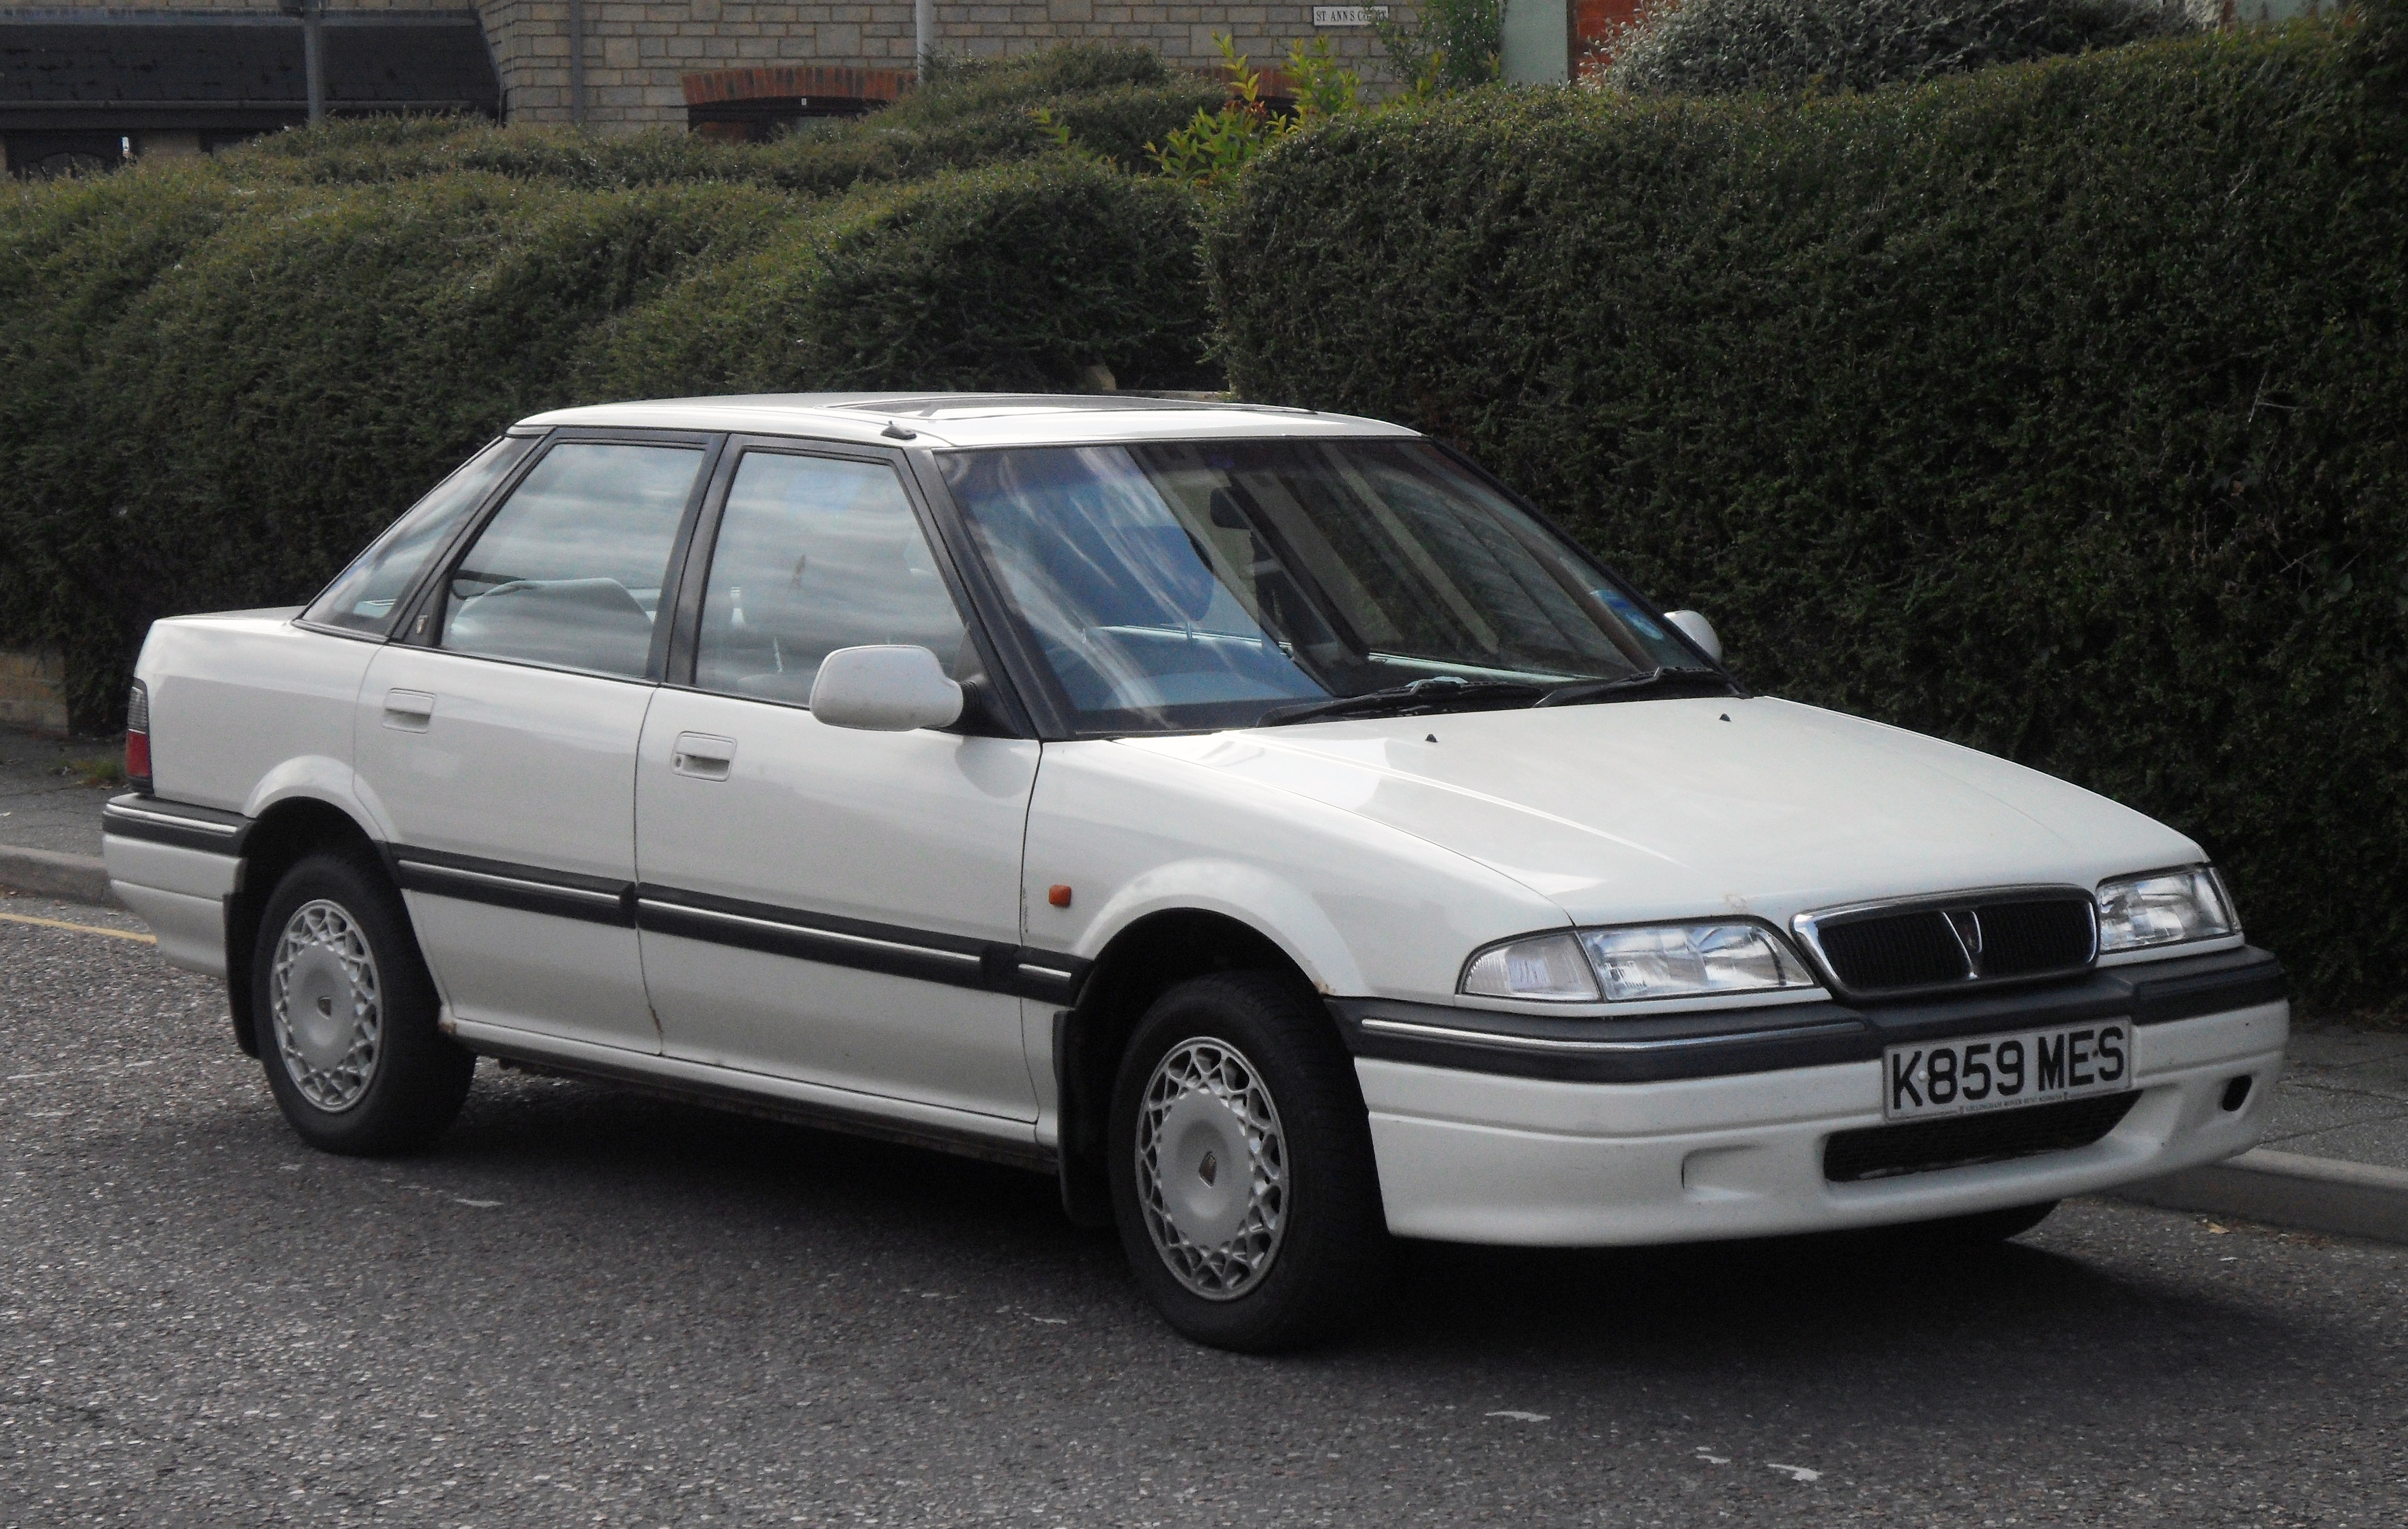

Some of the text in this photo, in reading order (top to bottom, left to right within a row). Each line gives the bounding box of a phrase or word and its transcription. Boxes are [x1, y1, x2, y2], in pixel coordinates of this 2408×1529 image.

[1316, 10, 1326, 21] ST
[1892, 1026, 2125, 1110] K859 MES
